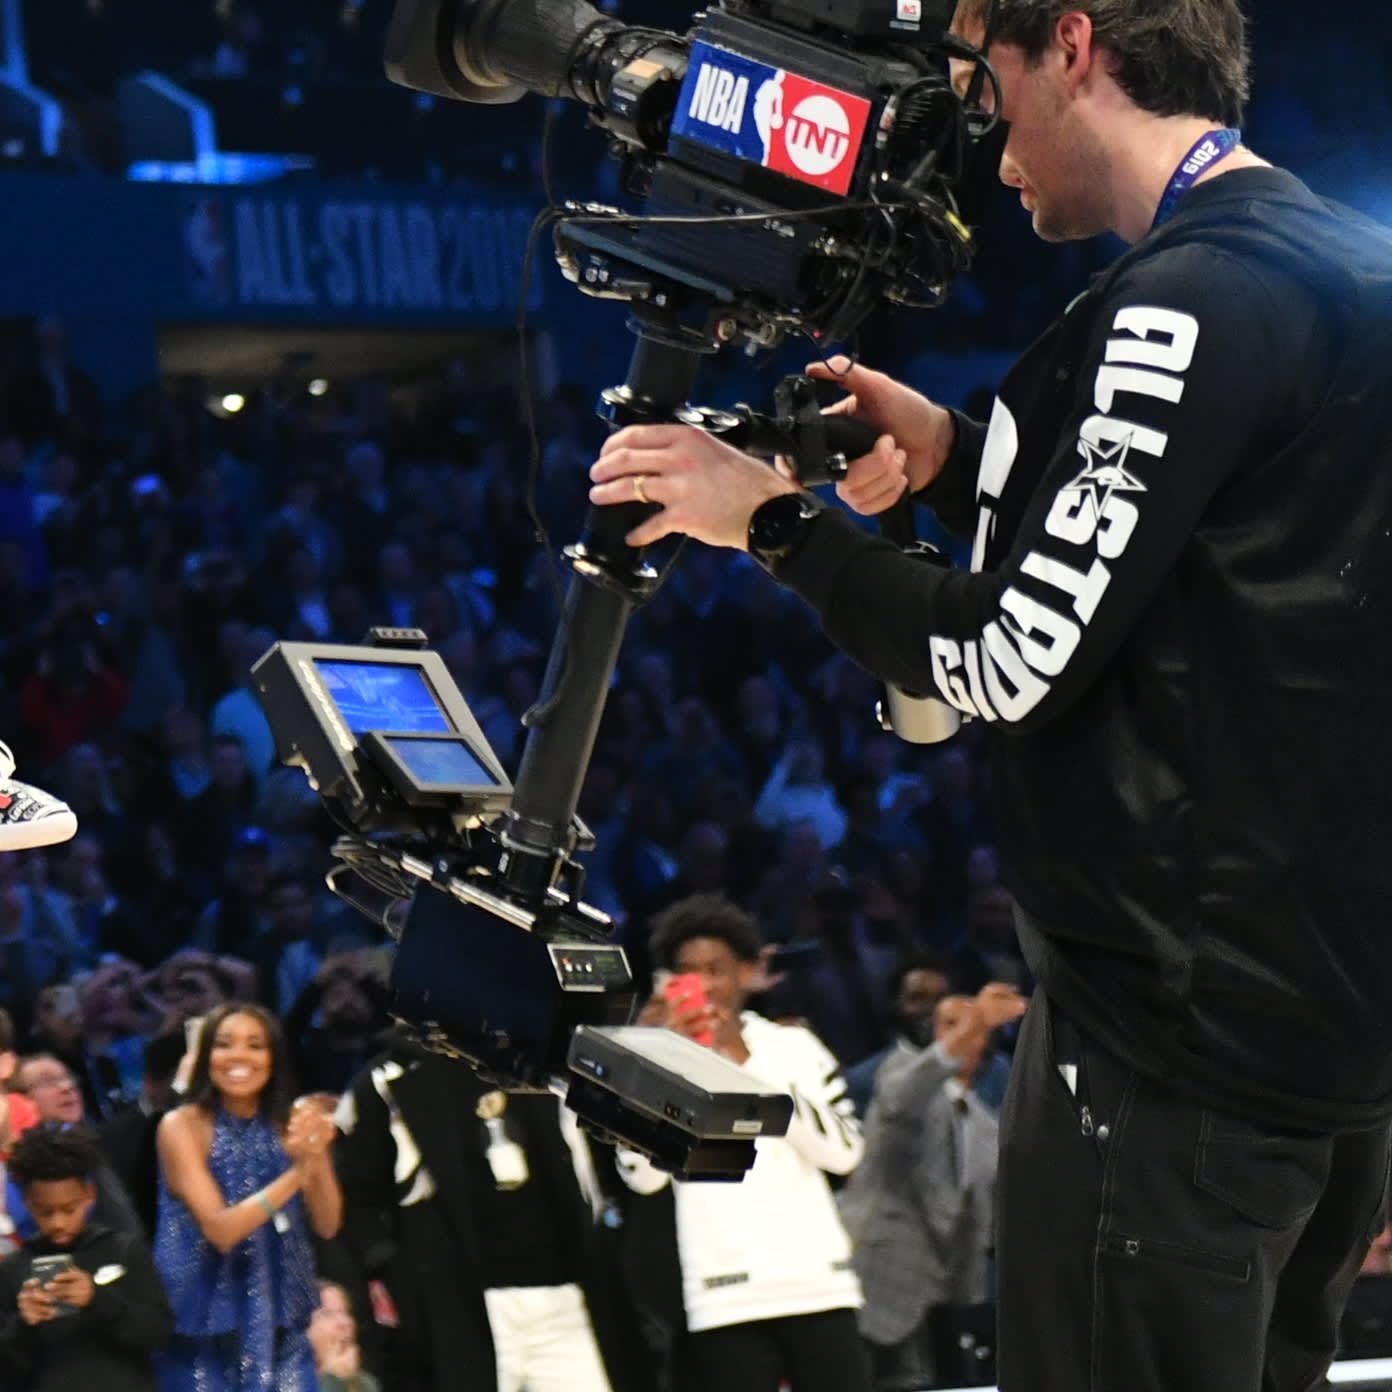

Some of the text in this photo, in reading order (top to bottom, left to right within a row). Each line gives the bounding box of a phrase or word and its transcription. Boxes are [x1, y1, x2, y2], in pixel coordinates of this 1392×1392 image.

[688, 63, 750, 134] NBA
[787, 110, 850, 161] TNT
[1182, 140, 1220, 175] 2019
